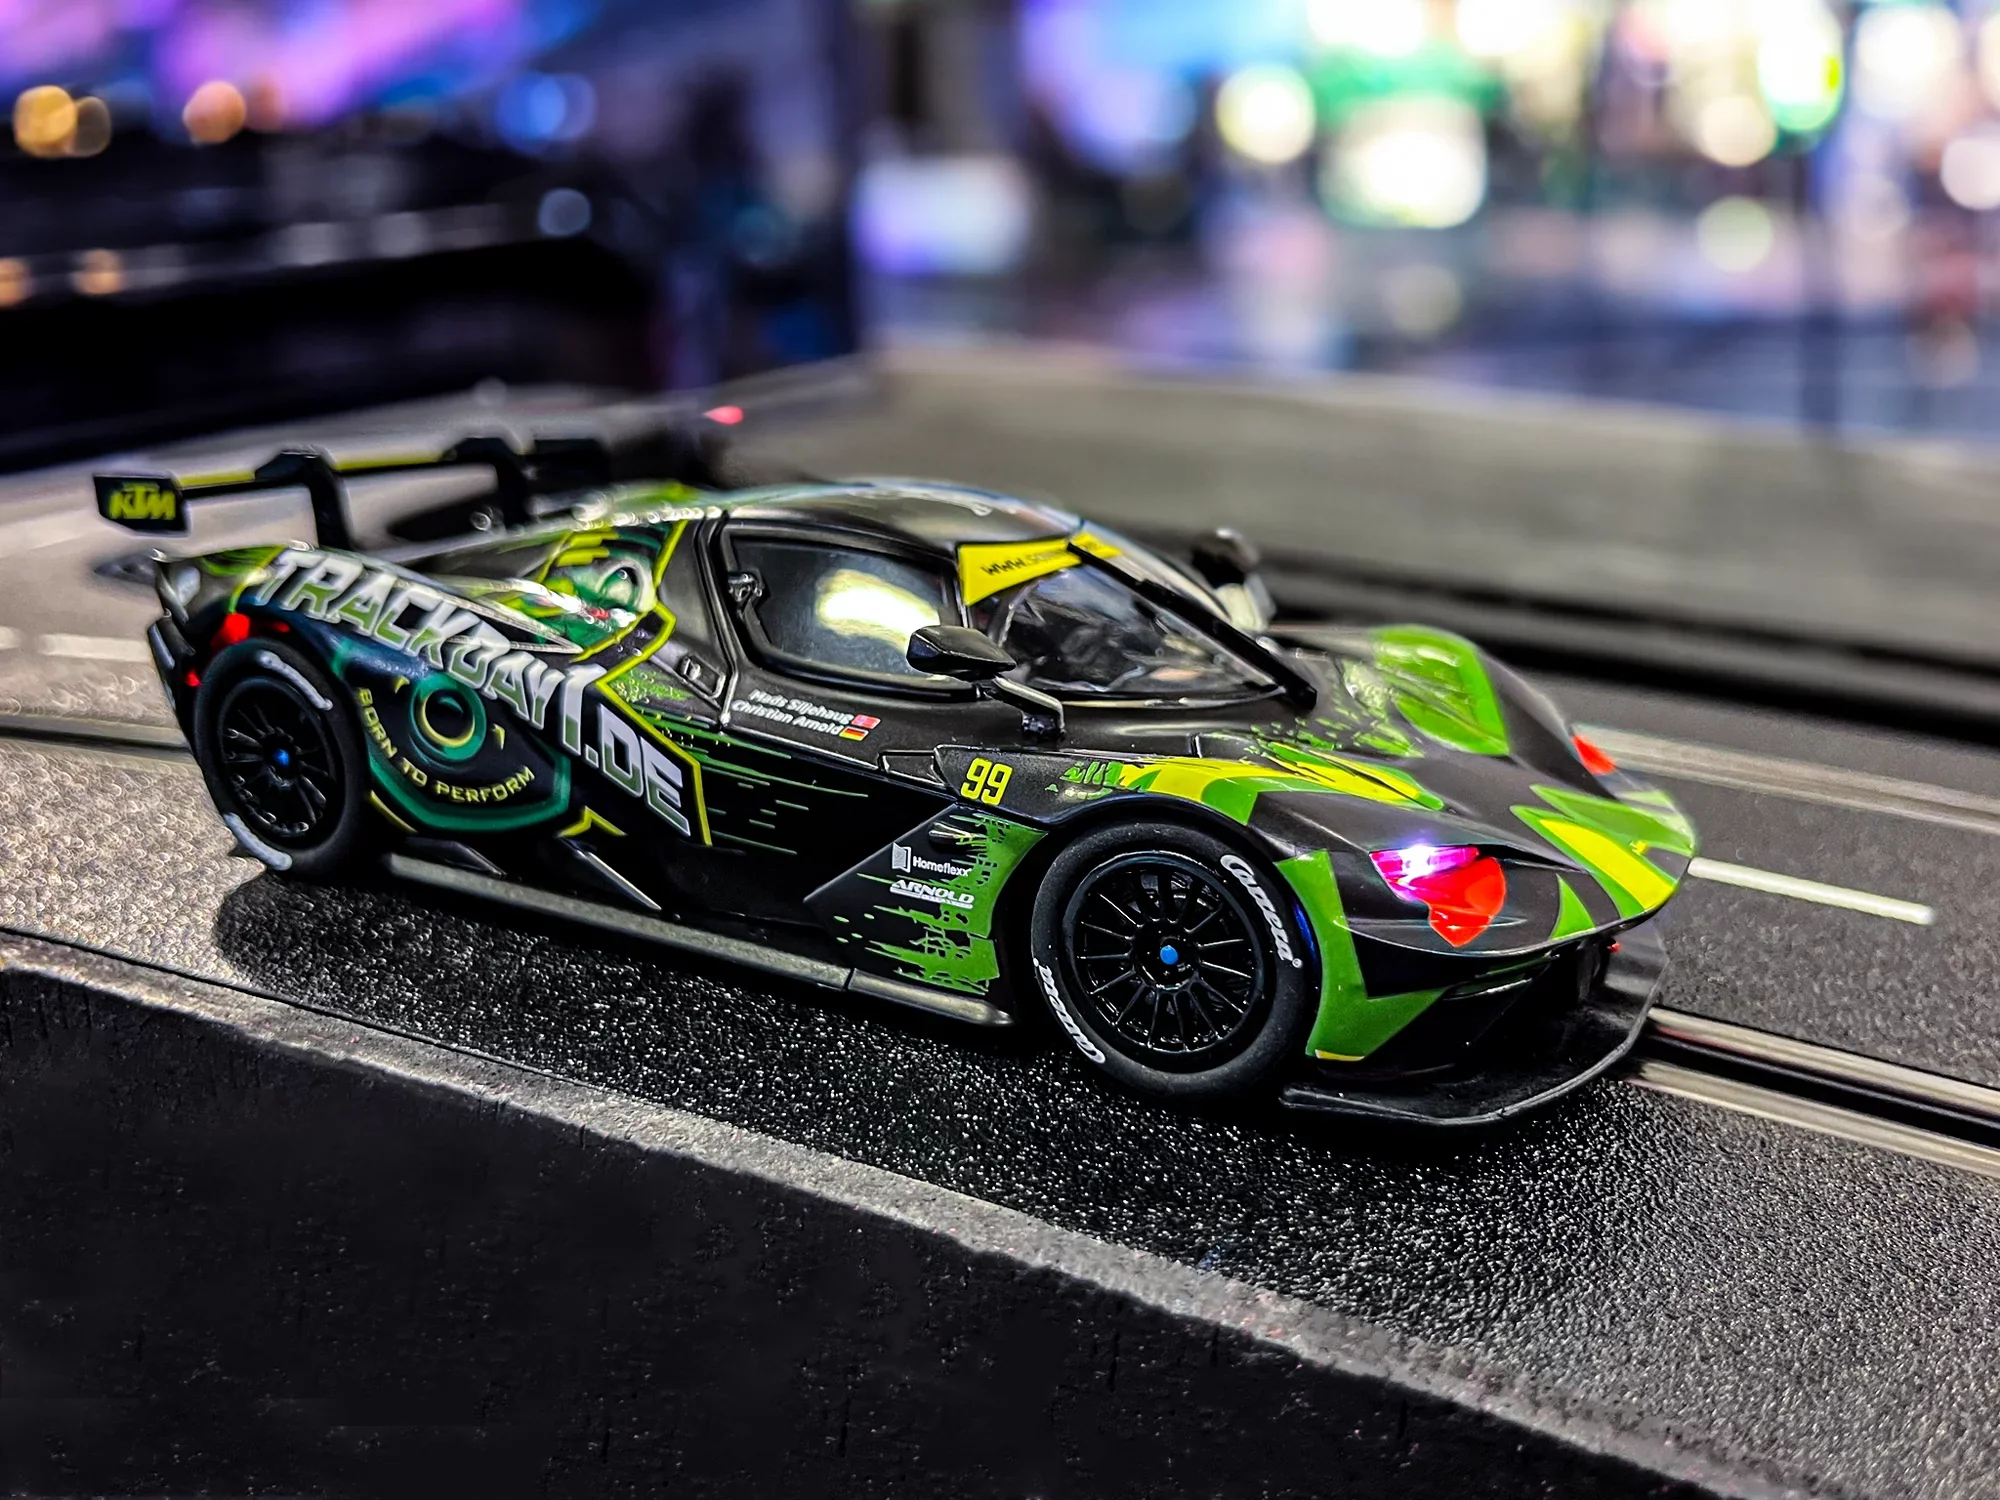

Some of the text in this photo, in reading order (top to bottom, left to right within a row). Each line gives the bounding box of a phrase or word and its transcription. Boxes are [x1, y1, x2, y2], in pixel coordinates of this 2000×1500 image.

[109, 482, 177, 520] KTM
[749, 688, 788, 708] Mads
[731, 699, 845, 736] Christian Arnold
[359, 687, 536, 804] BORN TO PERFORM
[960, 757, 1013, 806] 99
[891, 879, 975, 904] ARNOLD
